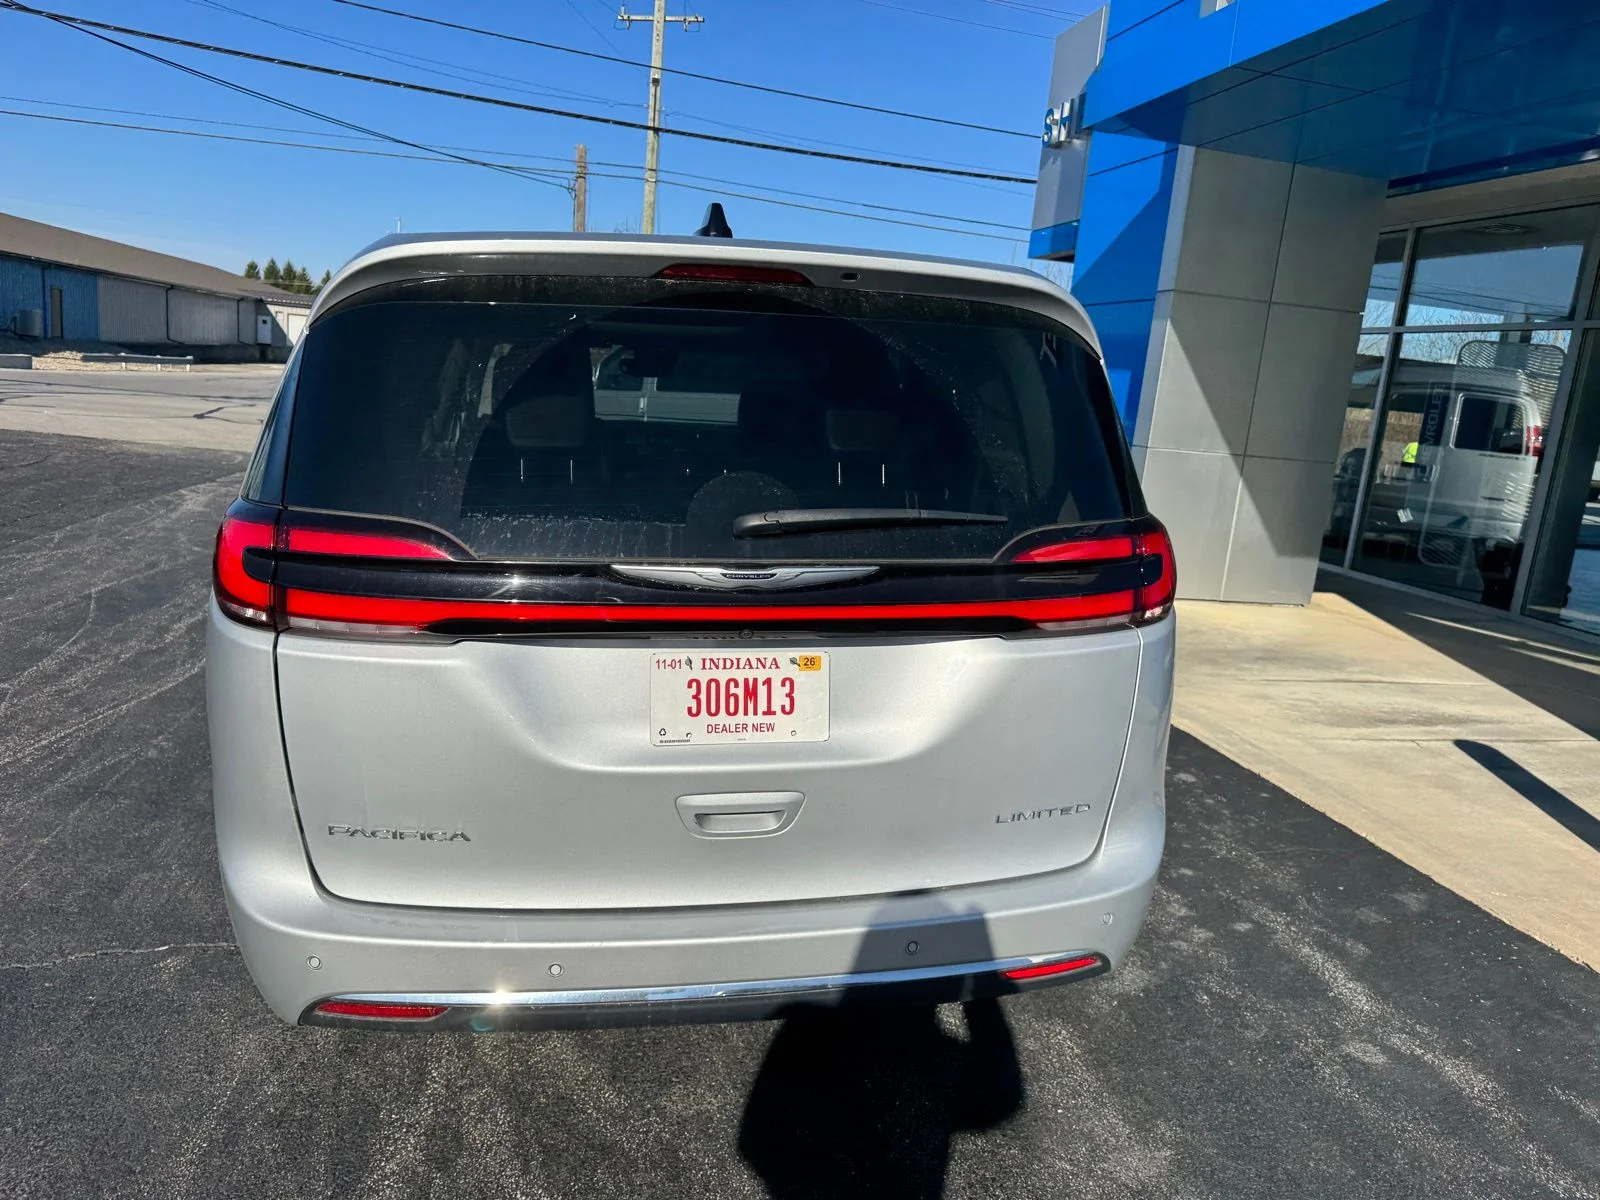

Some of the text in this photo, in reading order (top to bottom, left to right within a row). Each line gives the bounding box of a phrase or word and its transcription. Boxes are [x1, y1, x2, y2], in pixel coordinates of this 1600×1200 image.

[655, 658, 682, 670] 11-01
[700, 656, 781, 670] INDIANA
[803, 657, 816, 667] 26
[686, 676, 795, 718] 306M13
[706, 722, 775, 734] DEALER NEW
[995, 803, 1091, 824] LIMITED
[327, 824, 471, 842] PACIFICA
